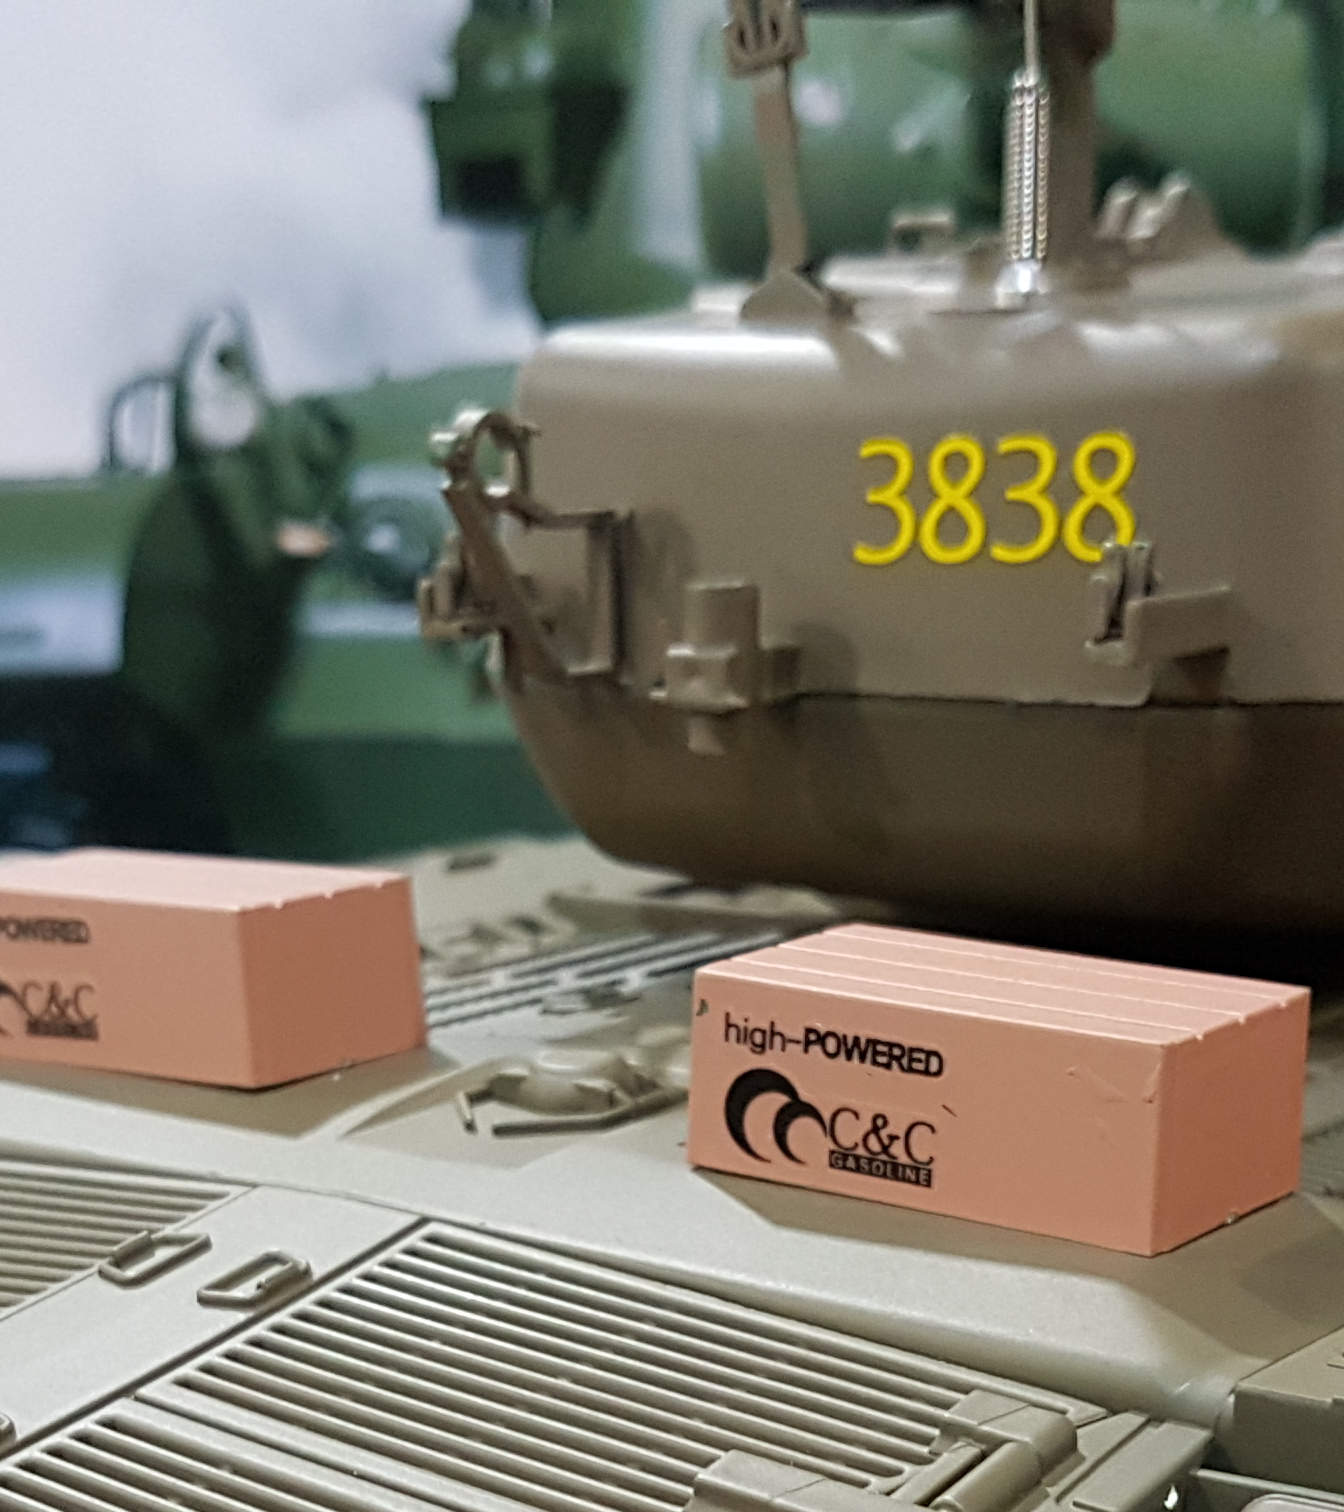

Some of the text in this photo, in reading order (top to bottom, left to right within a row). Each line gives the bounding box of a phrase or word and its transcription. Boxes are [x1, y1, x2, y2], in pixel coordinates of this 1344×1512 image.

[853, 431, 1137, 565] 3838
[724, 1012, 944, 1077] high-POWERED
[829, 1106, 937, 1166] C&C
[829, 1150, 932, 1188] GASOLINE
